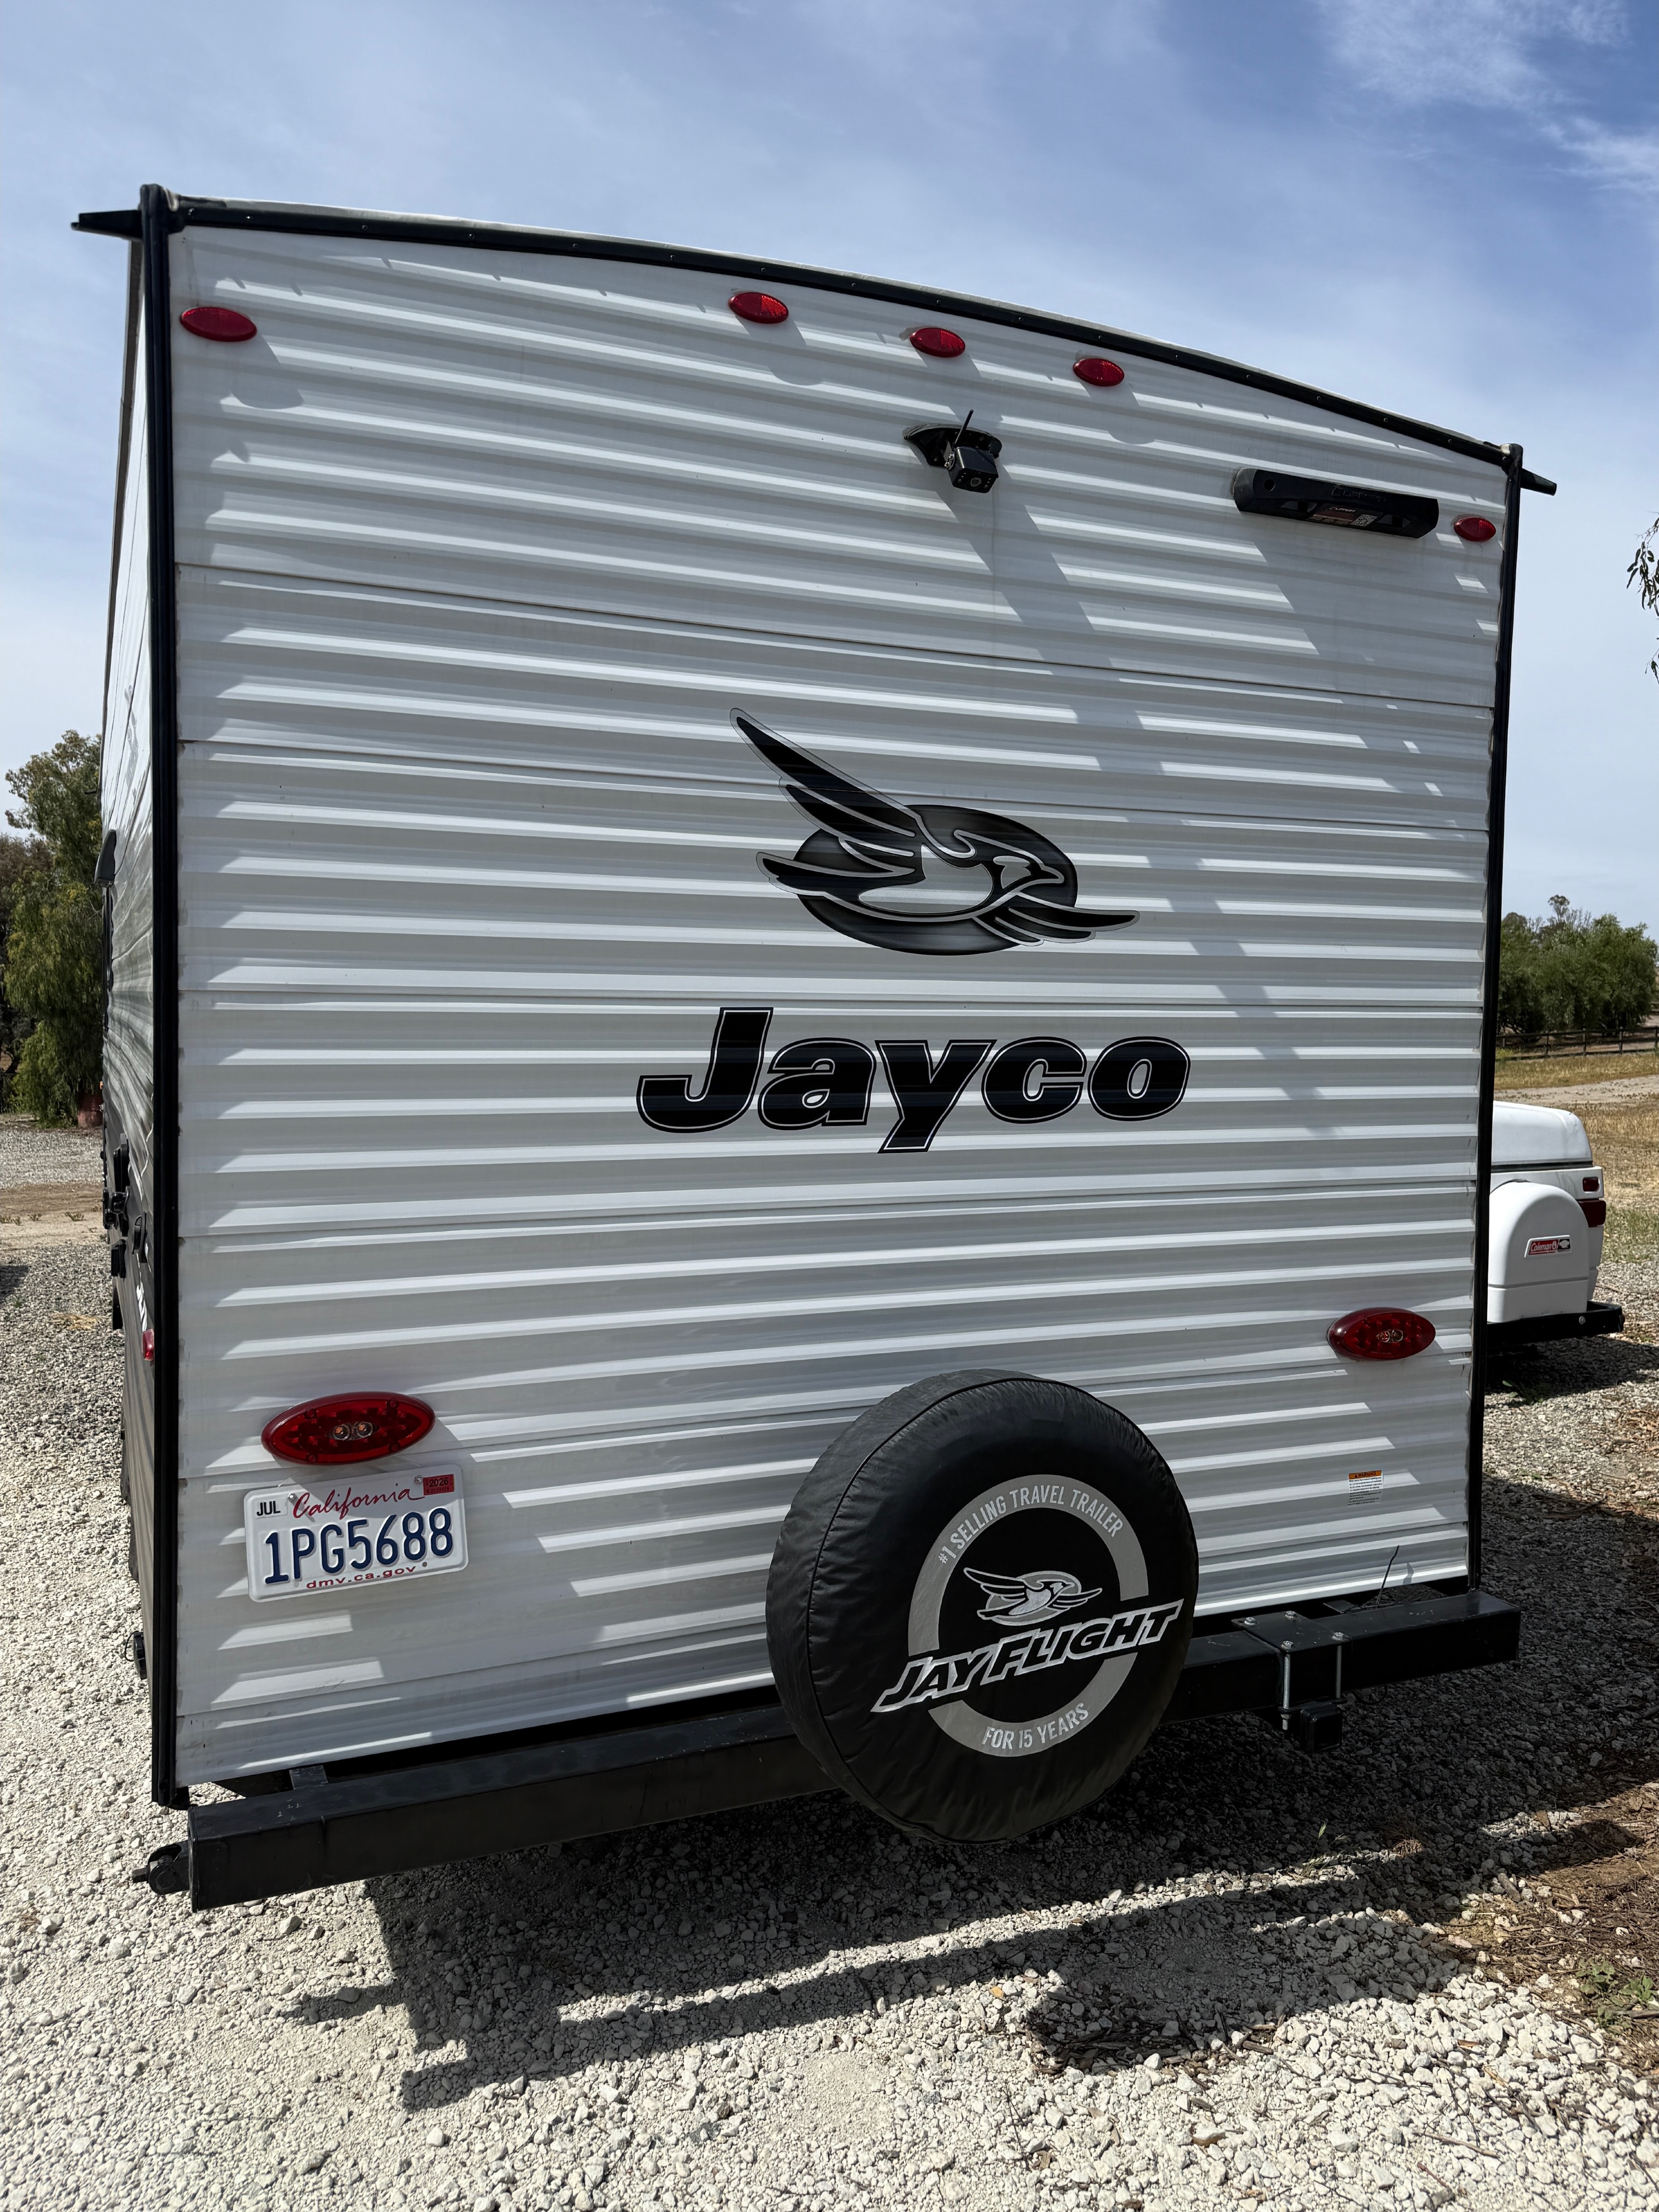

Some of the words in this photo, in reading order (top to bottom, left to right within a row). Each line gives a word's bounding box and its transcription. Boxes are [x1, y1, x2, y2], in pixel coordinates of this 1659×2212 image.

[637, 1007, 1191, 1154] Jayco
[1530, 1242, 1551, 1252] Coleman
[429, 1478, 449, 1487] 2026
[256, 1501, 281, 1516] JUL
[293, 1483, 425, 1520] California
[938, 1545, 956, 1564] #1
[950, 1495, 1007, 1549] SELLING
[1009, 1485, 1065, 1508] TRAVEL
[1070, 1489, 1123, 1538] TRAILER
[265, 1508, 453, 1584] 1PG5688
[306, 1566, 416, 1589] dmv.ca.gov
[982, 1726, 1014, 1749] FOR
[1019, 1729, 1033, 1748] 15
[1036, 1703, 1089, 1744] YEARS
